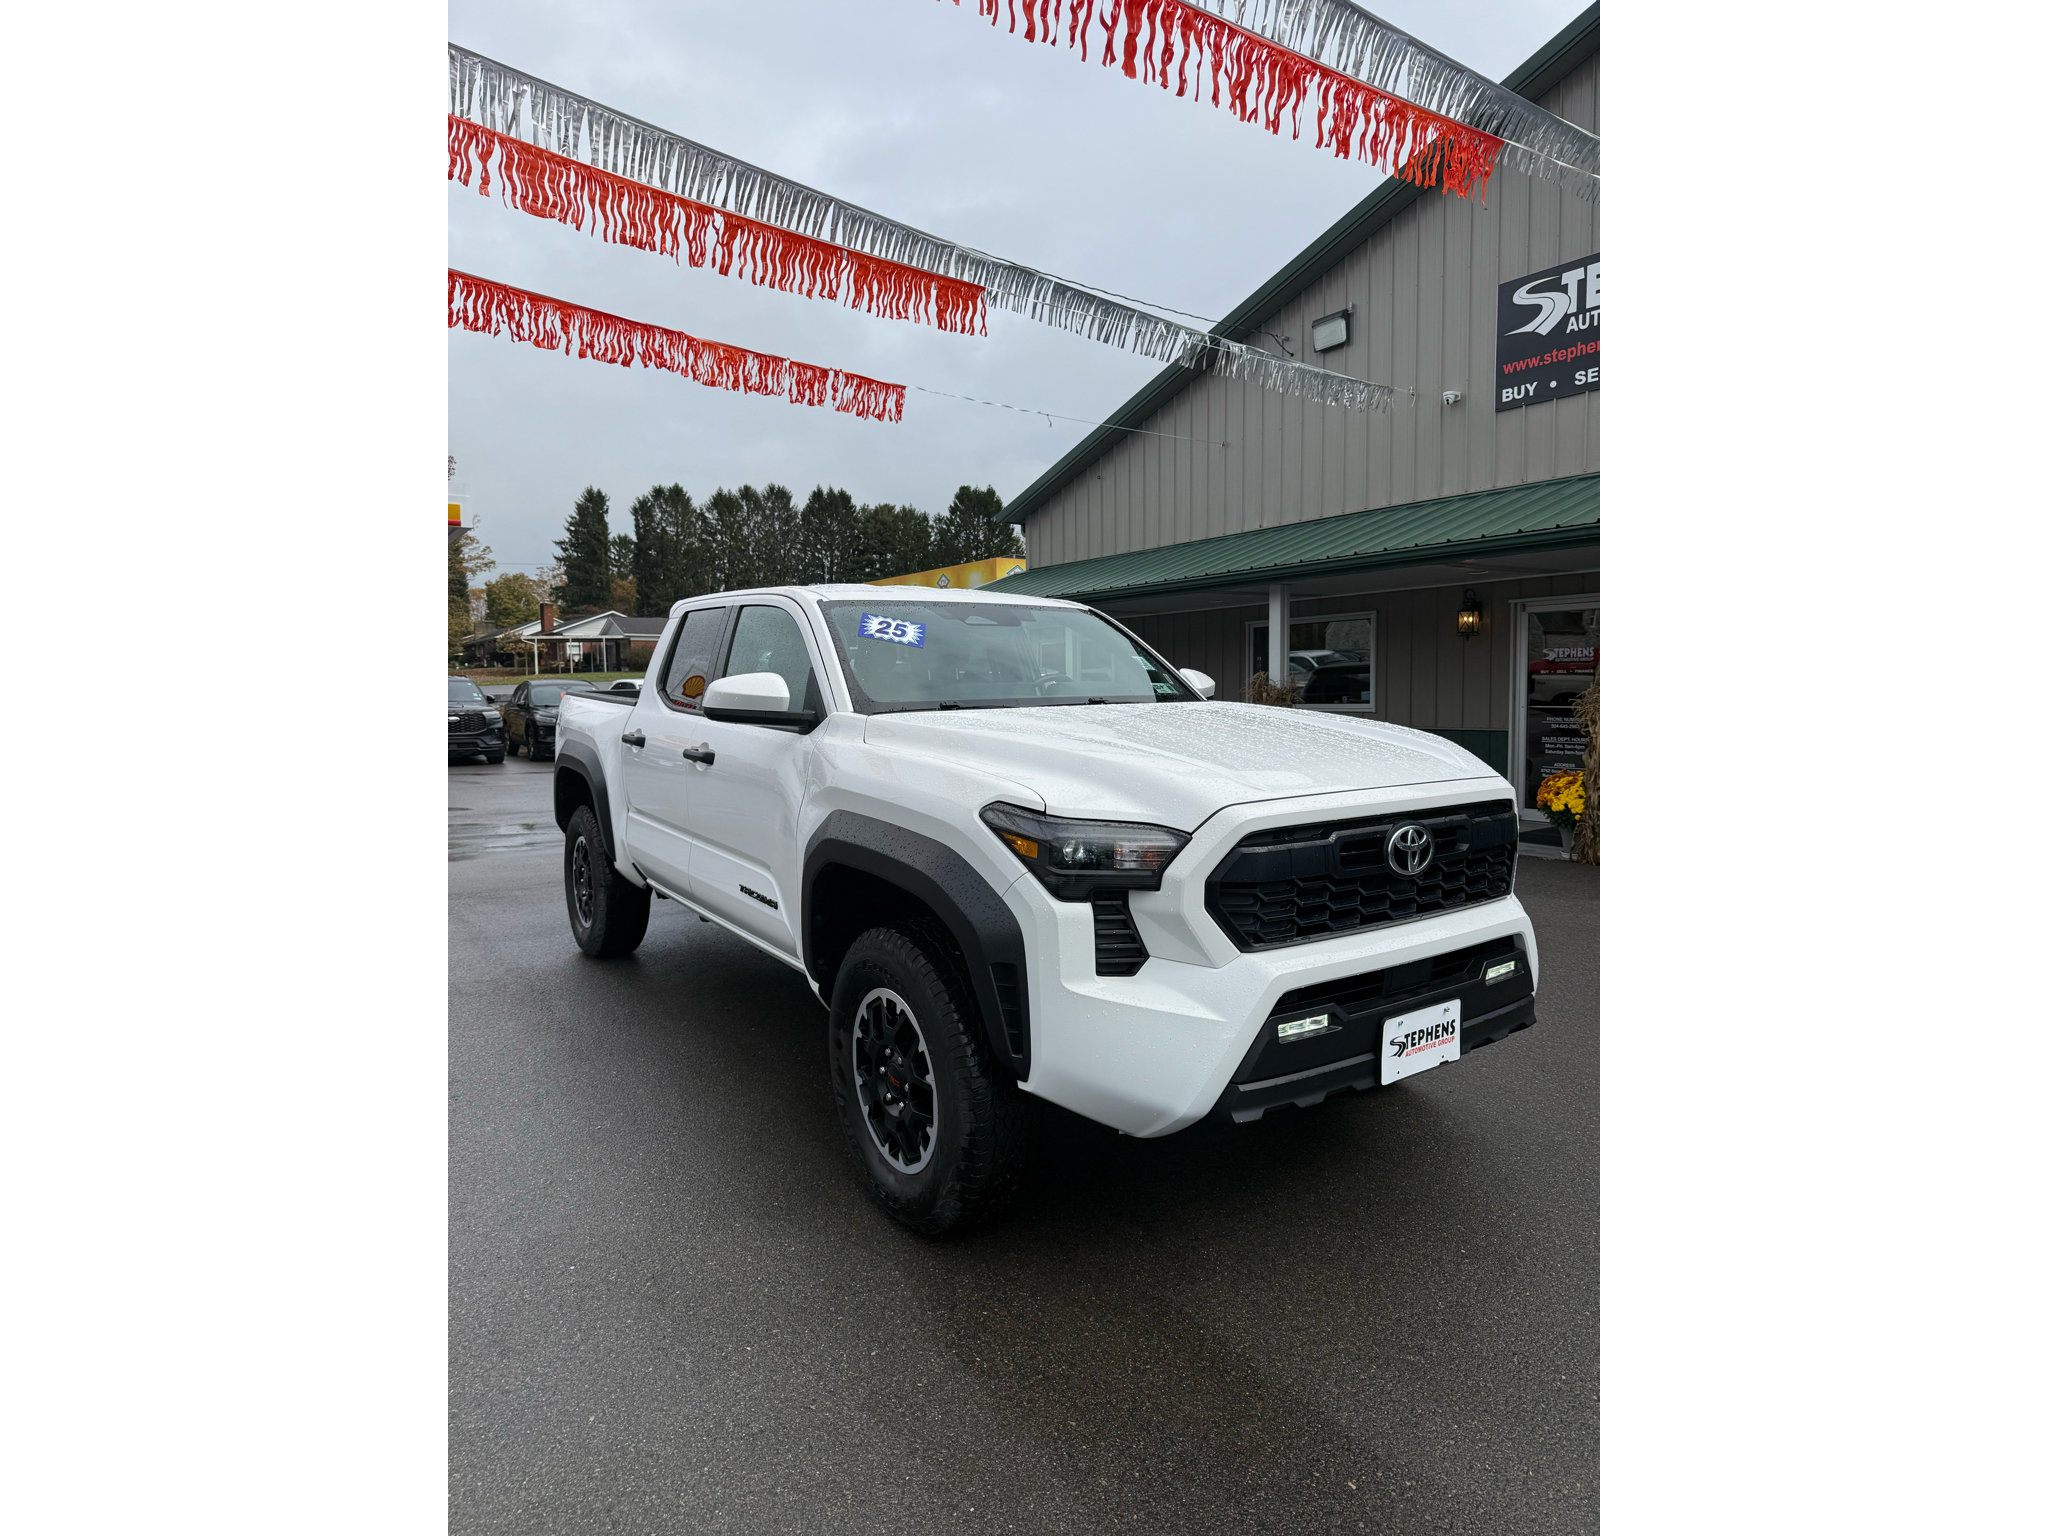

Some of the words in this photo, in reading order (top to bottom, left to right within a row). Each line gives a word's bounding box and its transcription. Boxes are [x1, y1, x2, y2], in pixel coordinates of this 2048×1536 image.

[1502, 382, 1538, 402] BUY
[875, 620, 908, 637] 25
[1542, 647, 1595, 661] STEPHENS
[1388, 1019, 1456, 1058] STEPHENS
[1405, 1040, 1437, 1057] AUTOMOTIVE
[1437, 1036, 1455, 1047] GROUP
